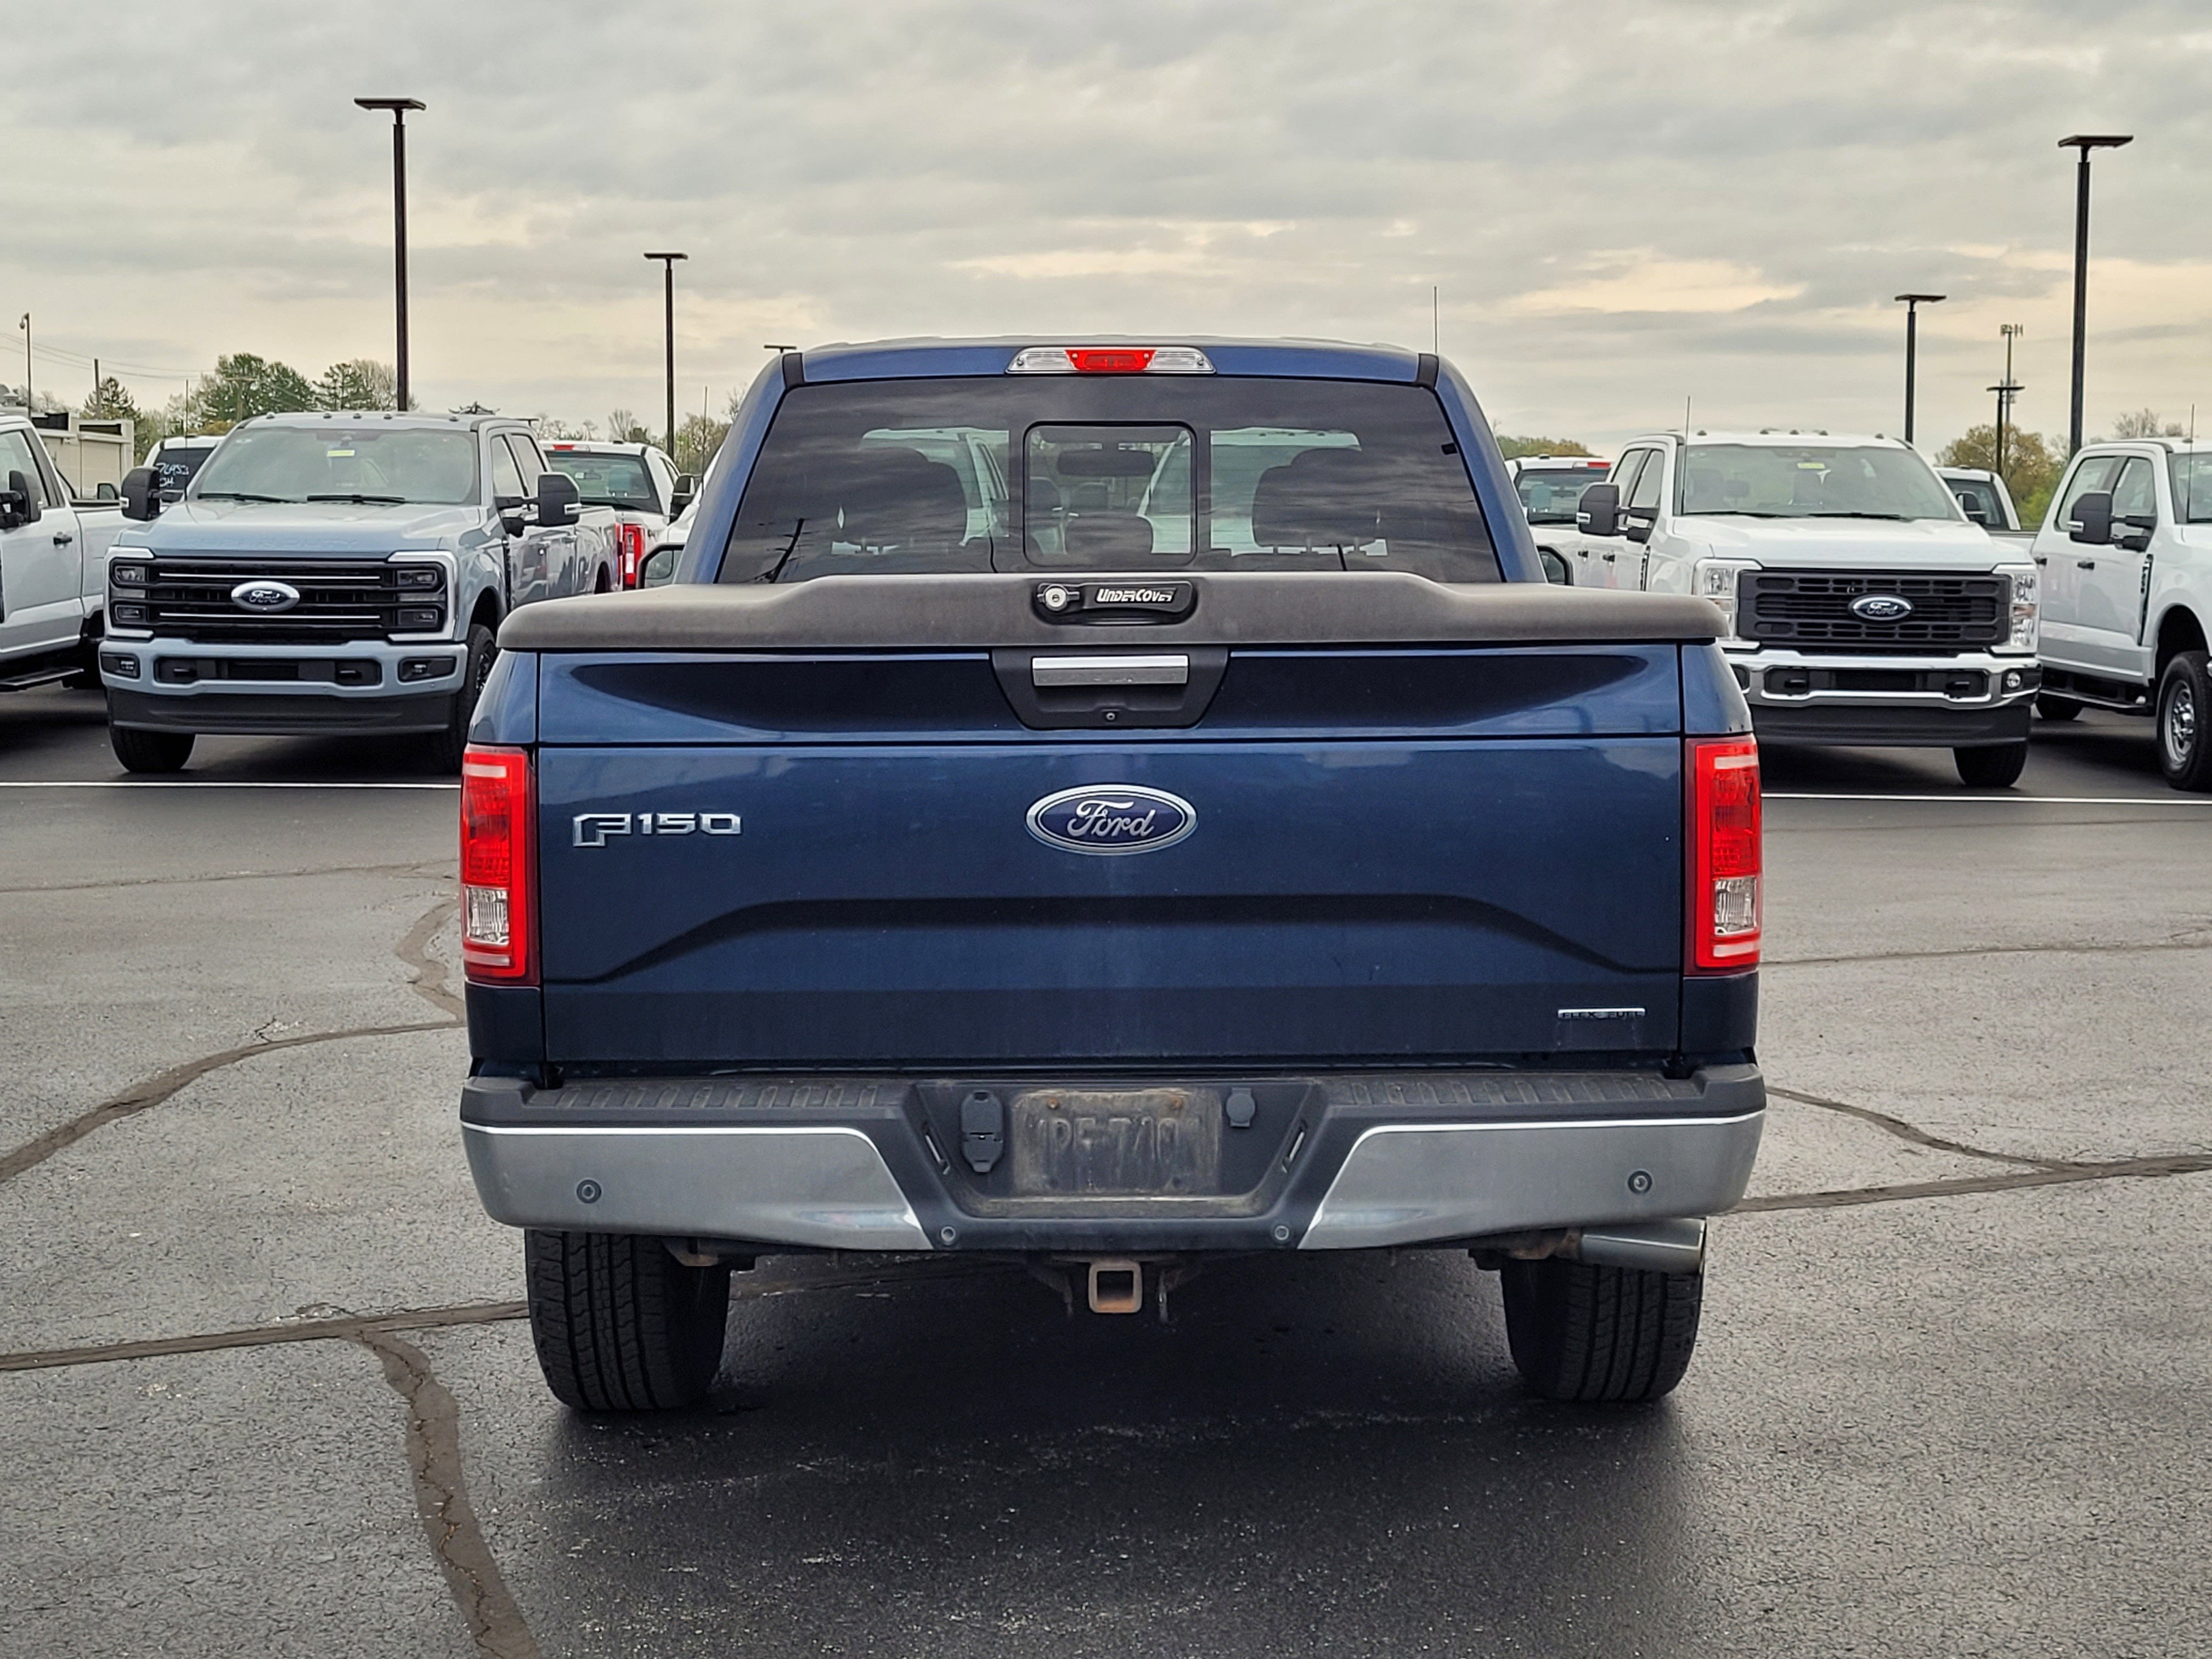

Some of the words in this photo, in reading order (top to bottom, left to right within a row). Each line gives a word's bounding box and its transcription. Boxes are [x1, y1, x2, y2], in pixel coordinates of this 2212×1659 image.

[249, 590, 280, 603] Ford
[1866, 602, 1898, 615] Ford
[1066, 799, 1156, 837] Ford
